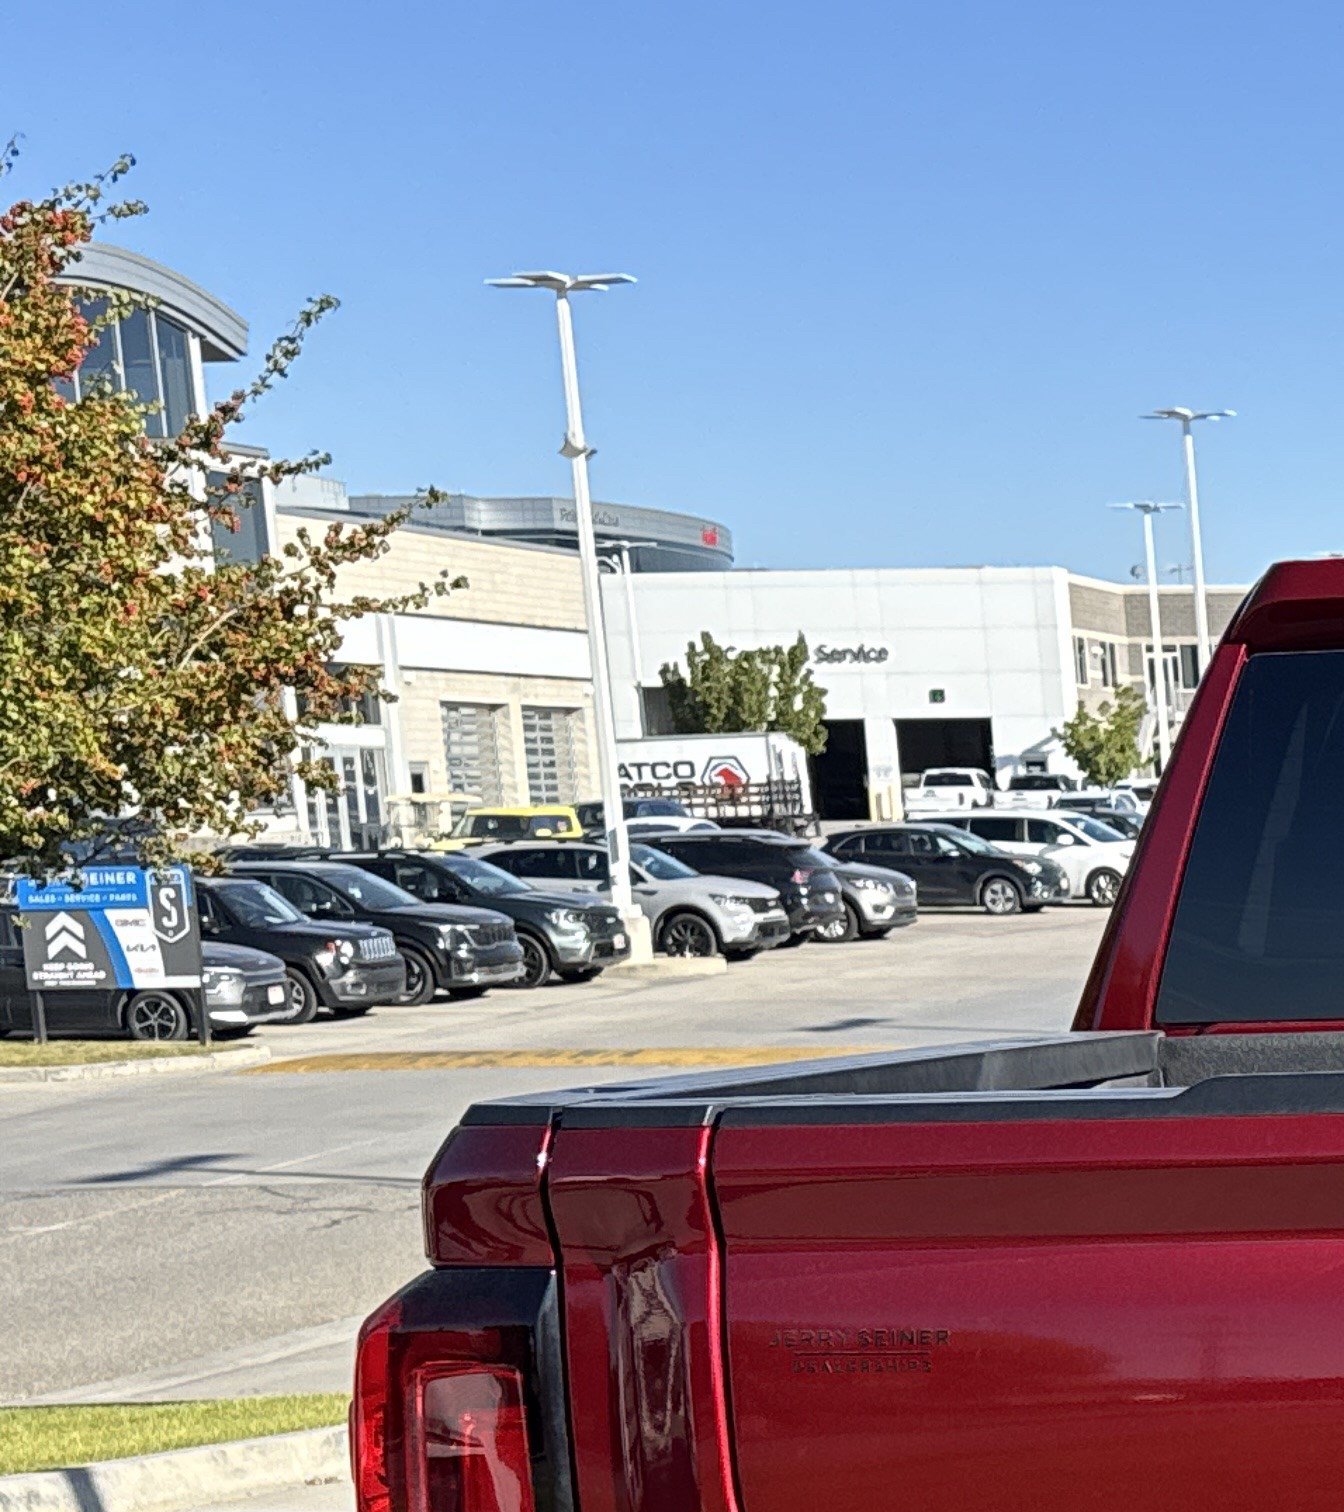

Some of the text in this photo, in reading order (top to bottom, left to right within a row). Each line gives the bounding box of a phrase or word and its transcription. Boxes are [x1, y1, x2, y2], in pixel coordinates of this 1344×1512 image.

[814, 643, 888, 664] Service
[617, 761, 696, 781] ATCO
[857, 1328, 951, 1348] SEINER
